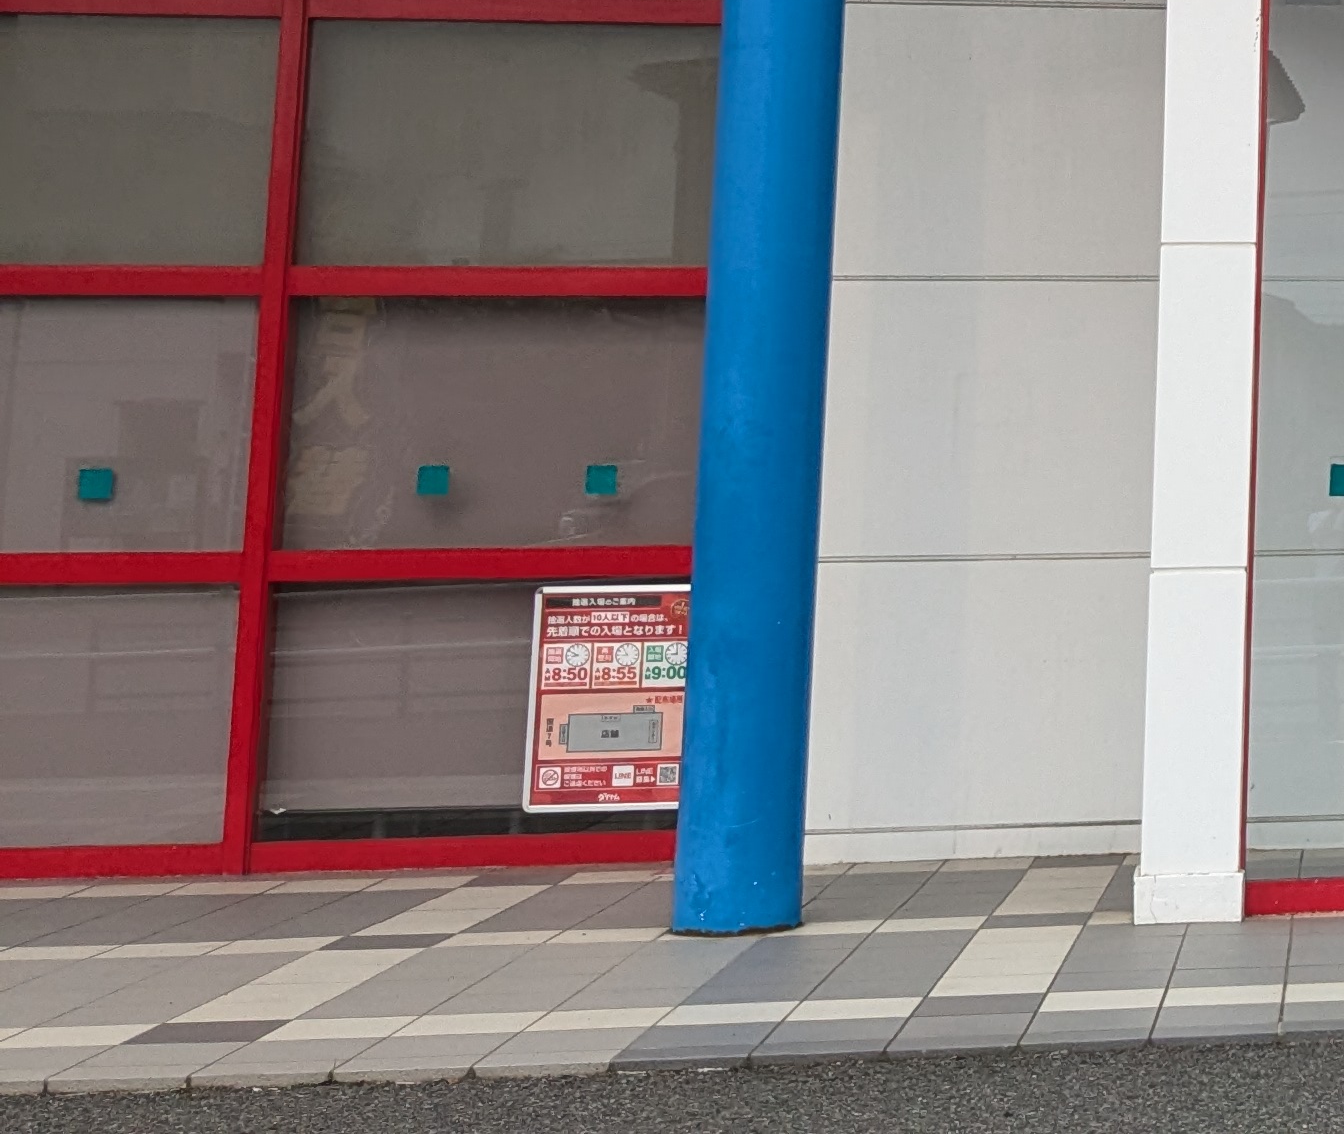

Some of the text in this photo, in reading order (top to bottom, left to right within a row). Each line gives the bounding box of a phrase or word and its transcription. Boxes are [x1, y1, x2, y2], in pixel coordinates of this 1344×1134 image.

[552, 667, 588, 681] 8:50
[601, 666, 637, 681] 8:55
[651, 666, 686, 680] 9:00
